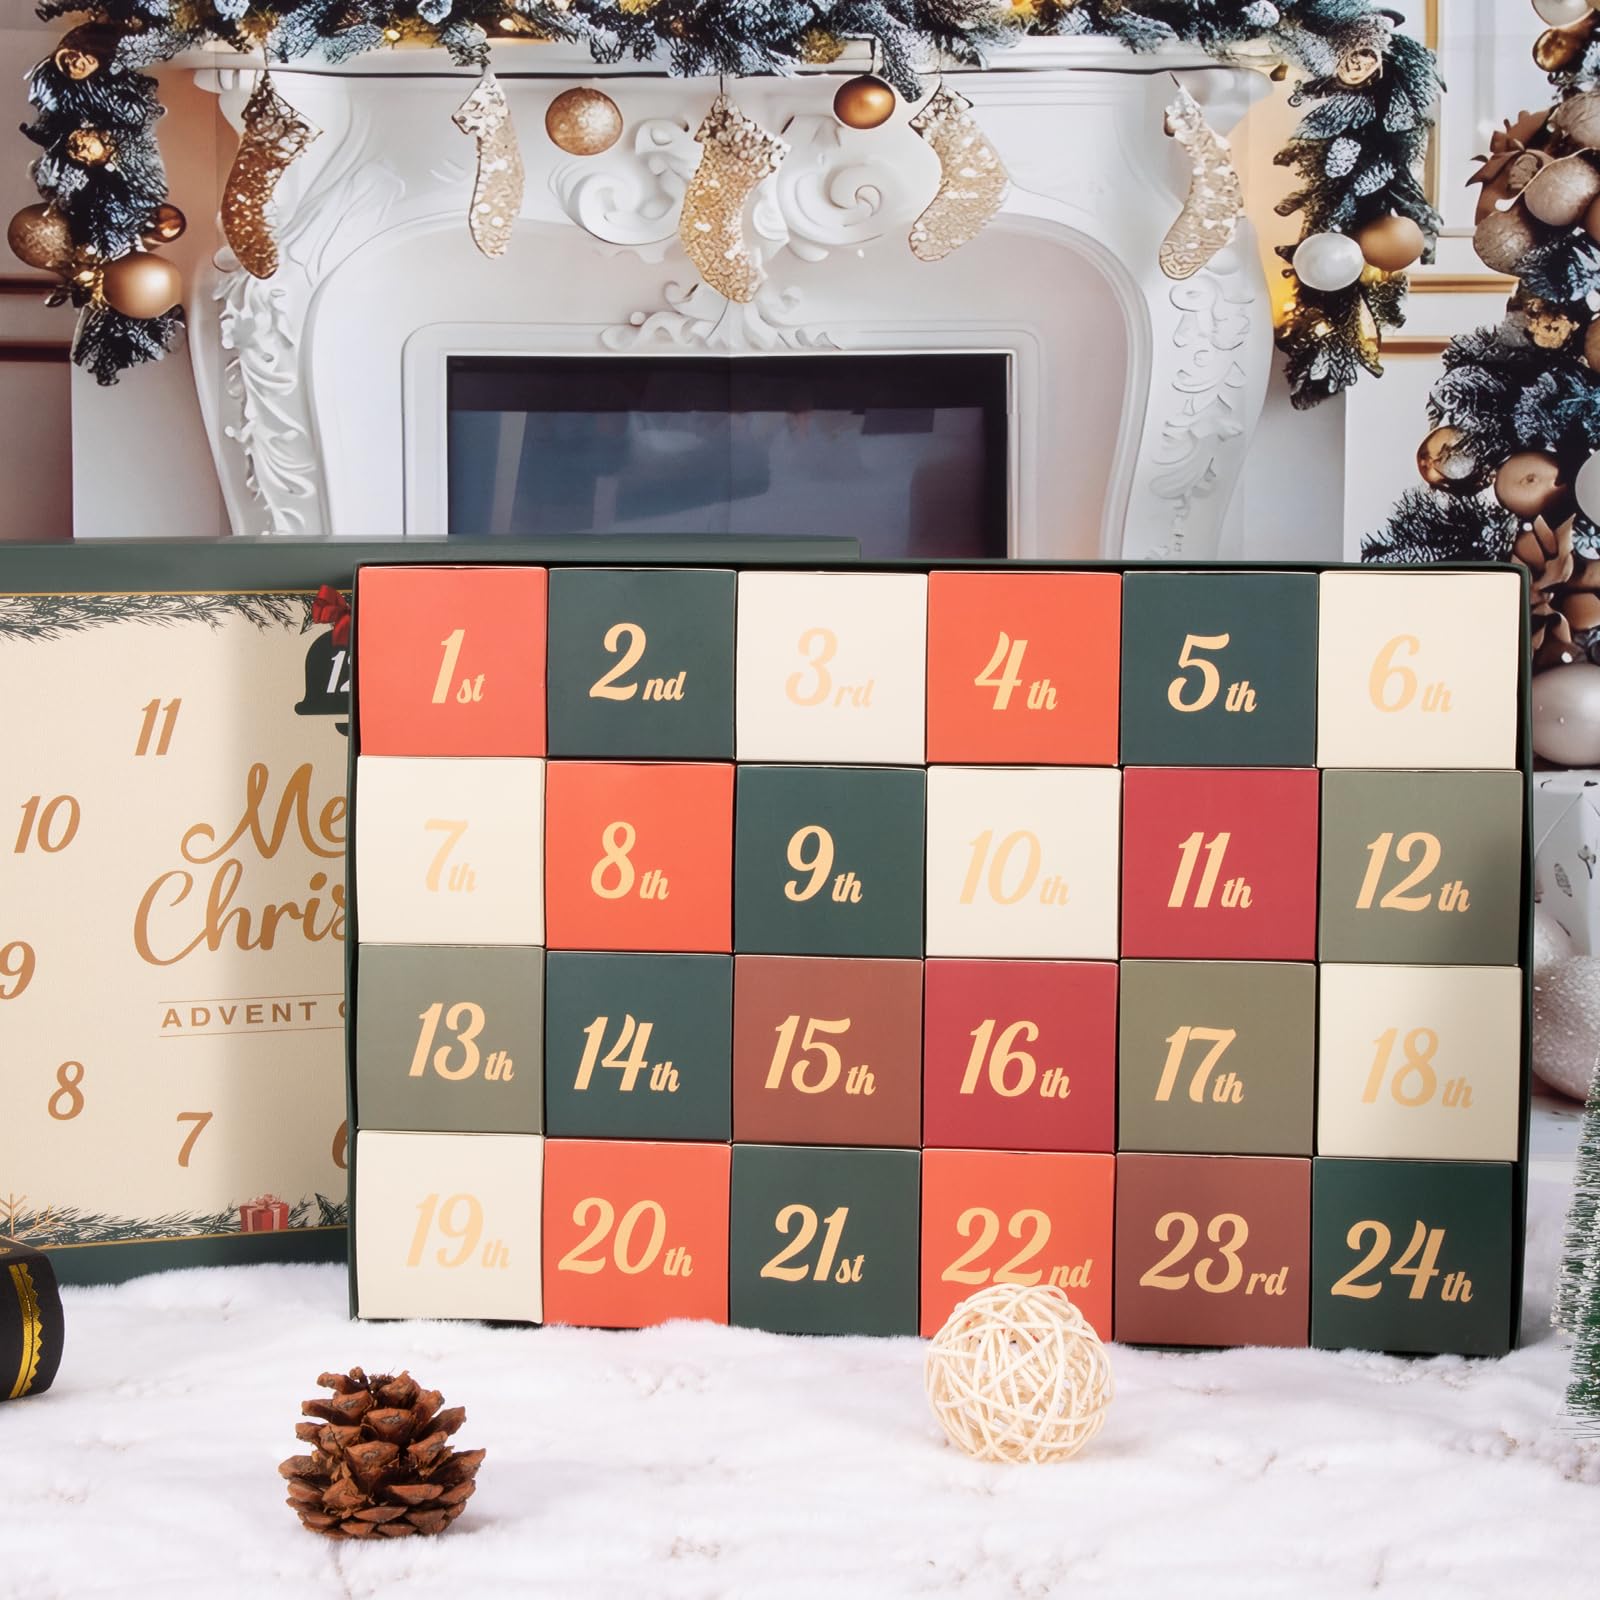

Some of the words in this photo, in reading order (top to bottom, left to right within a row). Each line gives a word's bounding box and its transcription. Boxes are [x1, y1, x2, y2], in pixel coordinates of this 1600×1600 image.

[326, 650, 350, 694] 1
[432, 630, 485, 703] 1st
[590, 623, 686, 701] 2nd
[785, 627, 874, 707] 3rd
[975, 632, 1057, 710] 4th
[1168, 633, 1256, 712] 5th
[1368, 635, 1452, 713] 6th
[134, 697, 182, 756] 11
[14, 794, 81, 854] 10
[425, 819, 476, 893] 7th
[591, 822, 669, 900] 8th
[785, 826, 862, 903] 9th
[960, 830, 1068, 905] 10th
[1168, 832, 1252, 908] 11th
[1356, 832, 1470, 914] 12th
[0, 940, 36, 1000] 9
[161, 1001, 318, 1029] ADVENT
[409, 1002, 513, 1081] 13th
[574, 1014, 679, 1092] 14th
[48, 1060, 85, 1121] 8
[765, 1016, 875, 1095] 15th
[960, 1020, 1070, 1098] 16th
[1155, 1026, 1243, 1103] 17th
[1363, 1027, 1472, 1108] 18th
[176, 1111, 213, 1168] 7
[406, 1193, 509, 1269] 19th
[559, 1198, 693, 1276] 20th
[760, 1204, 864, 1283] 21st
[941, 1207, 1093, 1288] 22nd
[1140, 1212, 1288, 1295] 23rd
[1331, 1220, 1472, 1302] 24th
